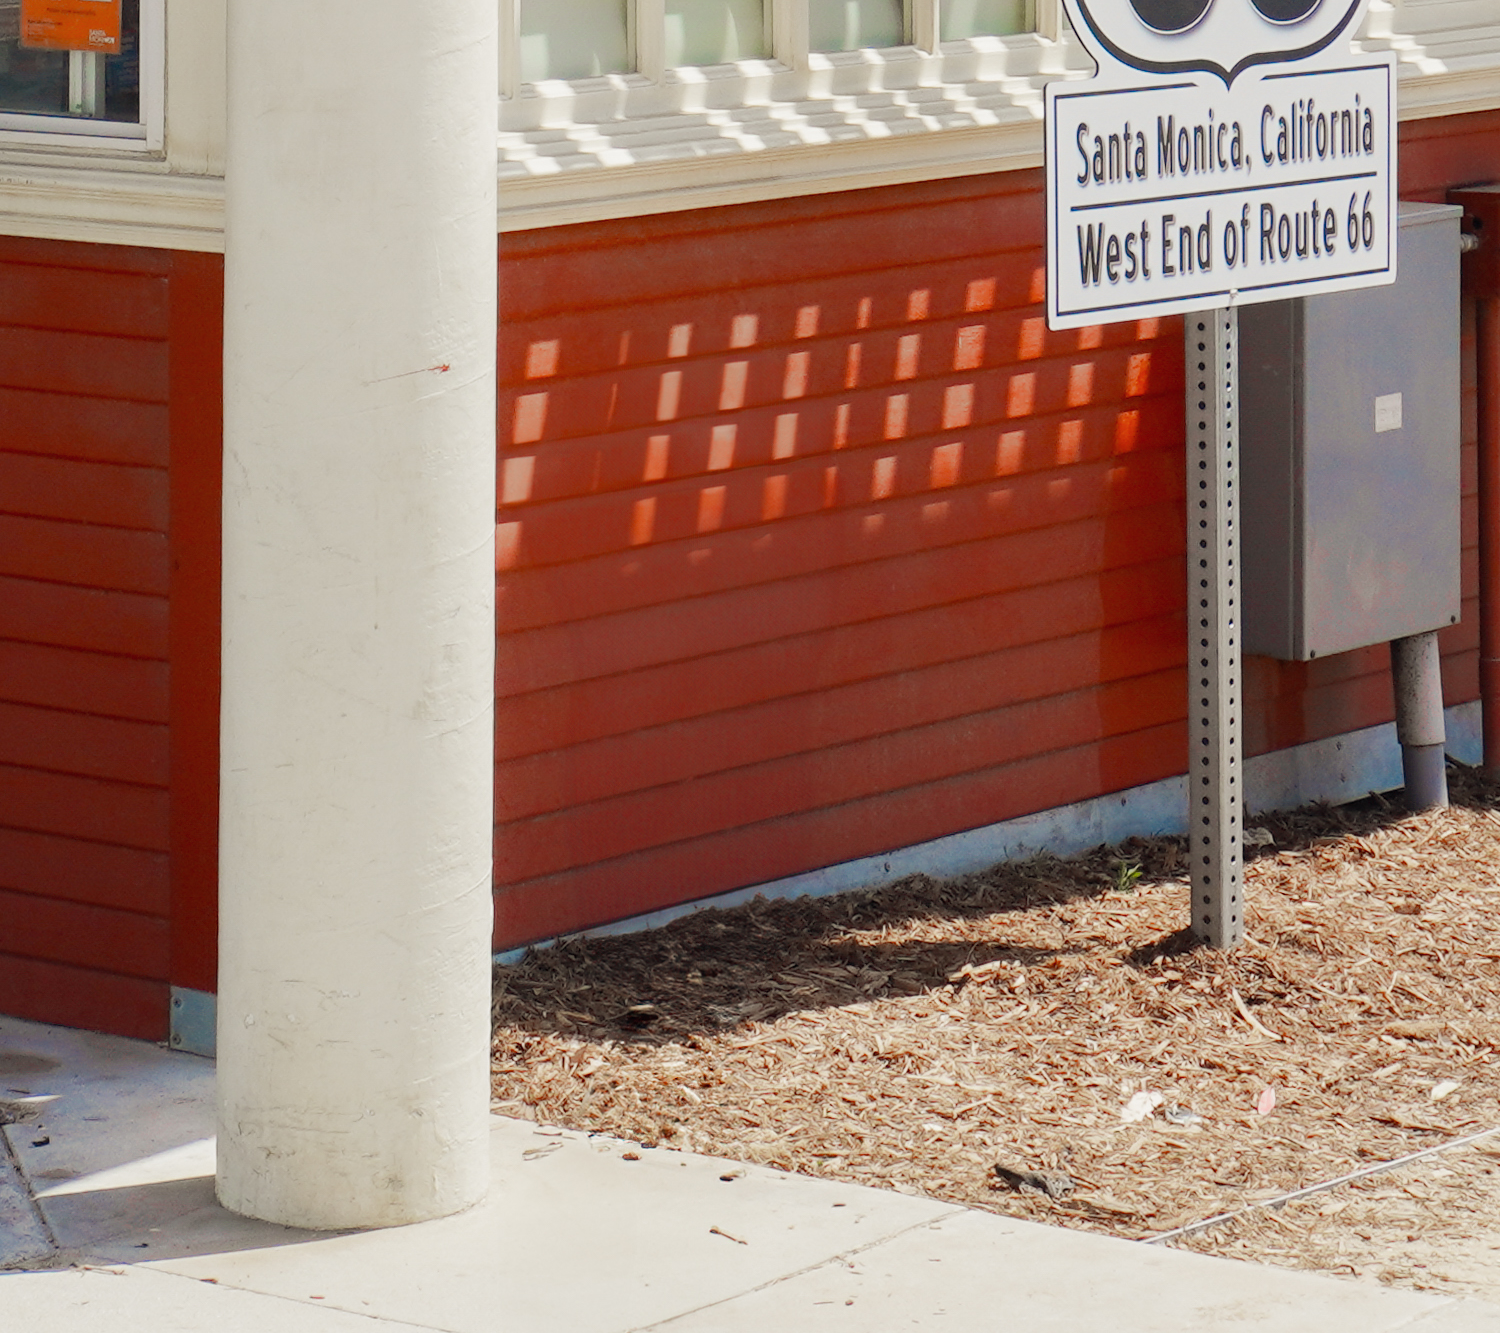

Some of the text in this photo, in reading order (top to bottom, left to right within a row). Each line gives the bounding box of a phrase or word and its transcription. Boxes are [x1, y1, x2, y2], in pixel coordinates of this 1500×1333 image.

[1075, 92, 1376, 189] Santa Monica, California
[1076, 189, 1376, 287] West End of Route 66
